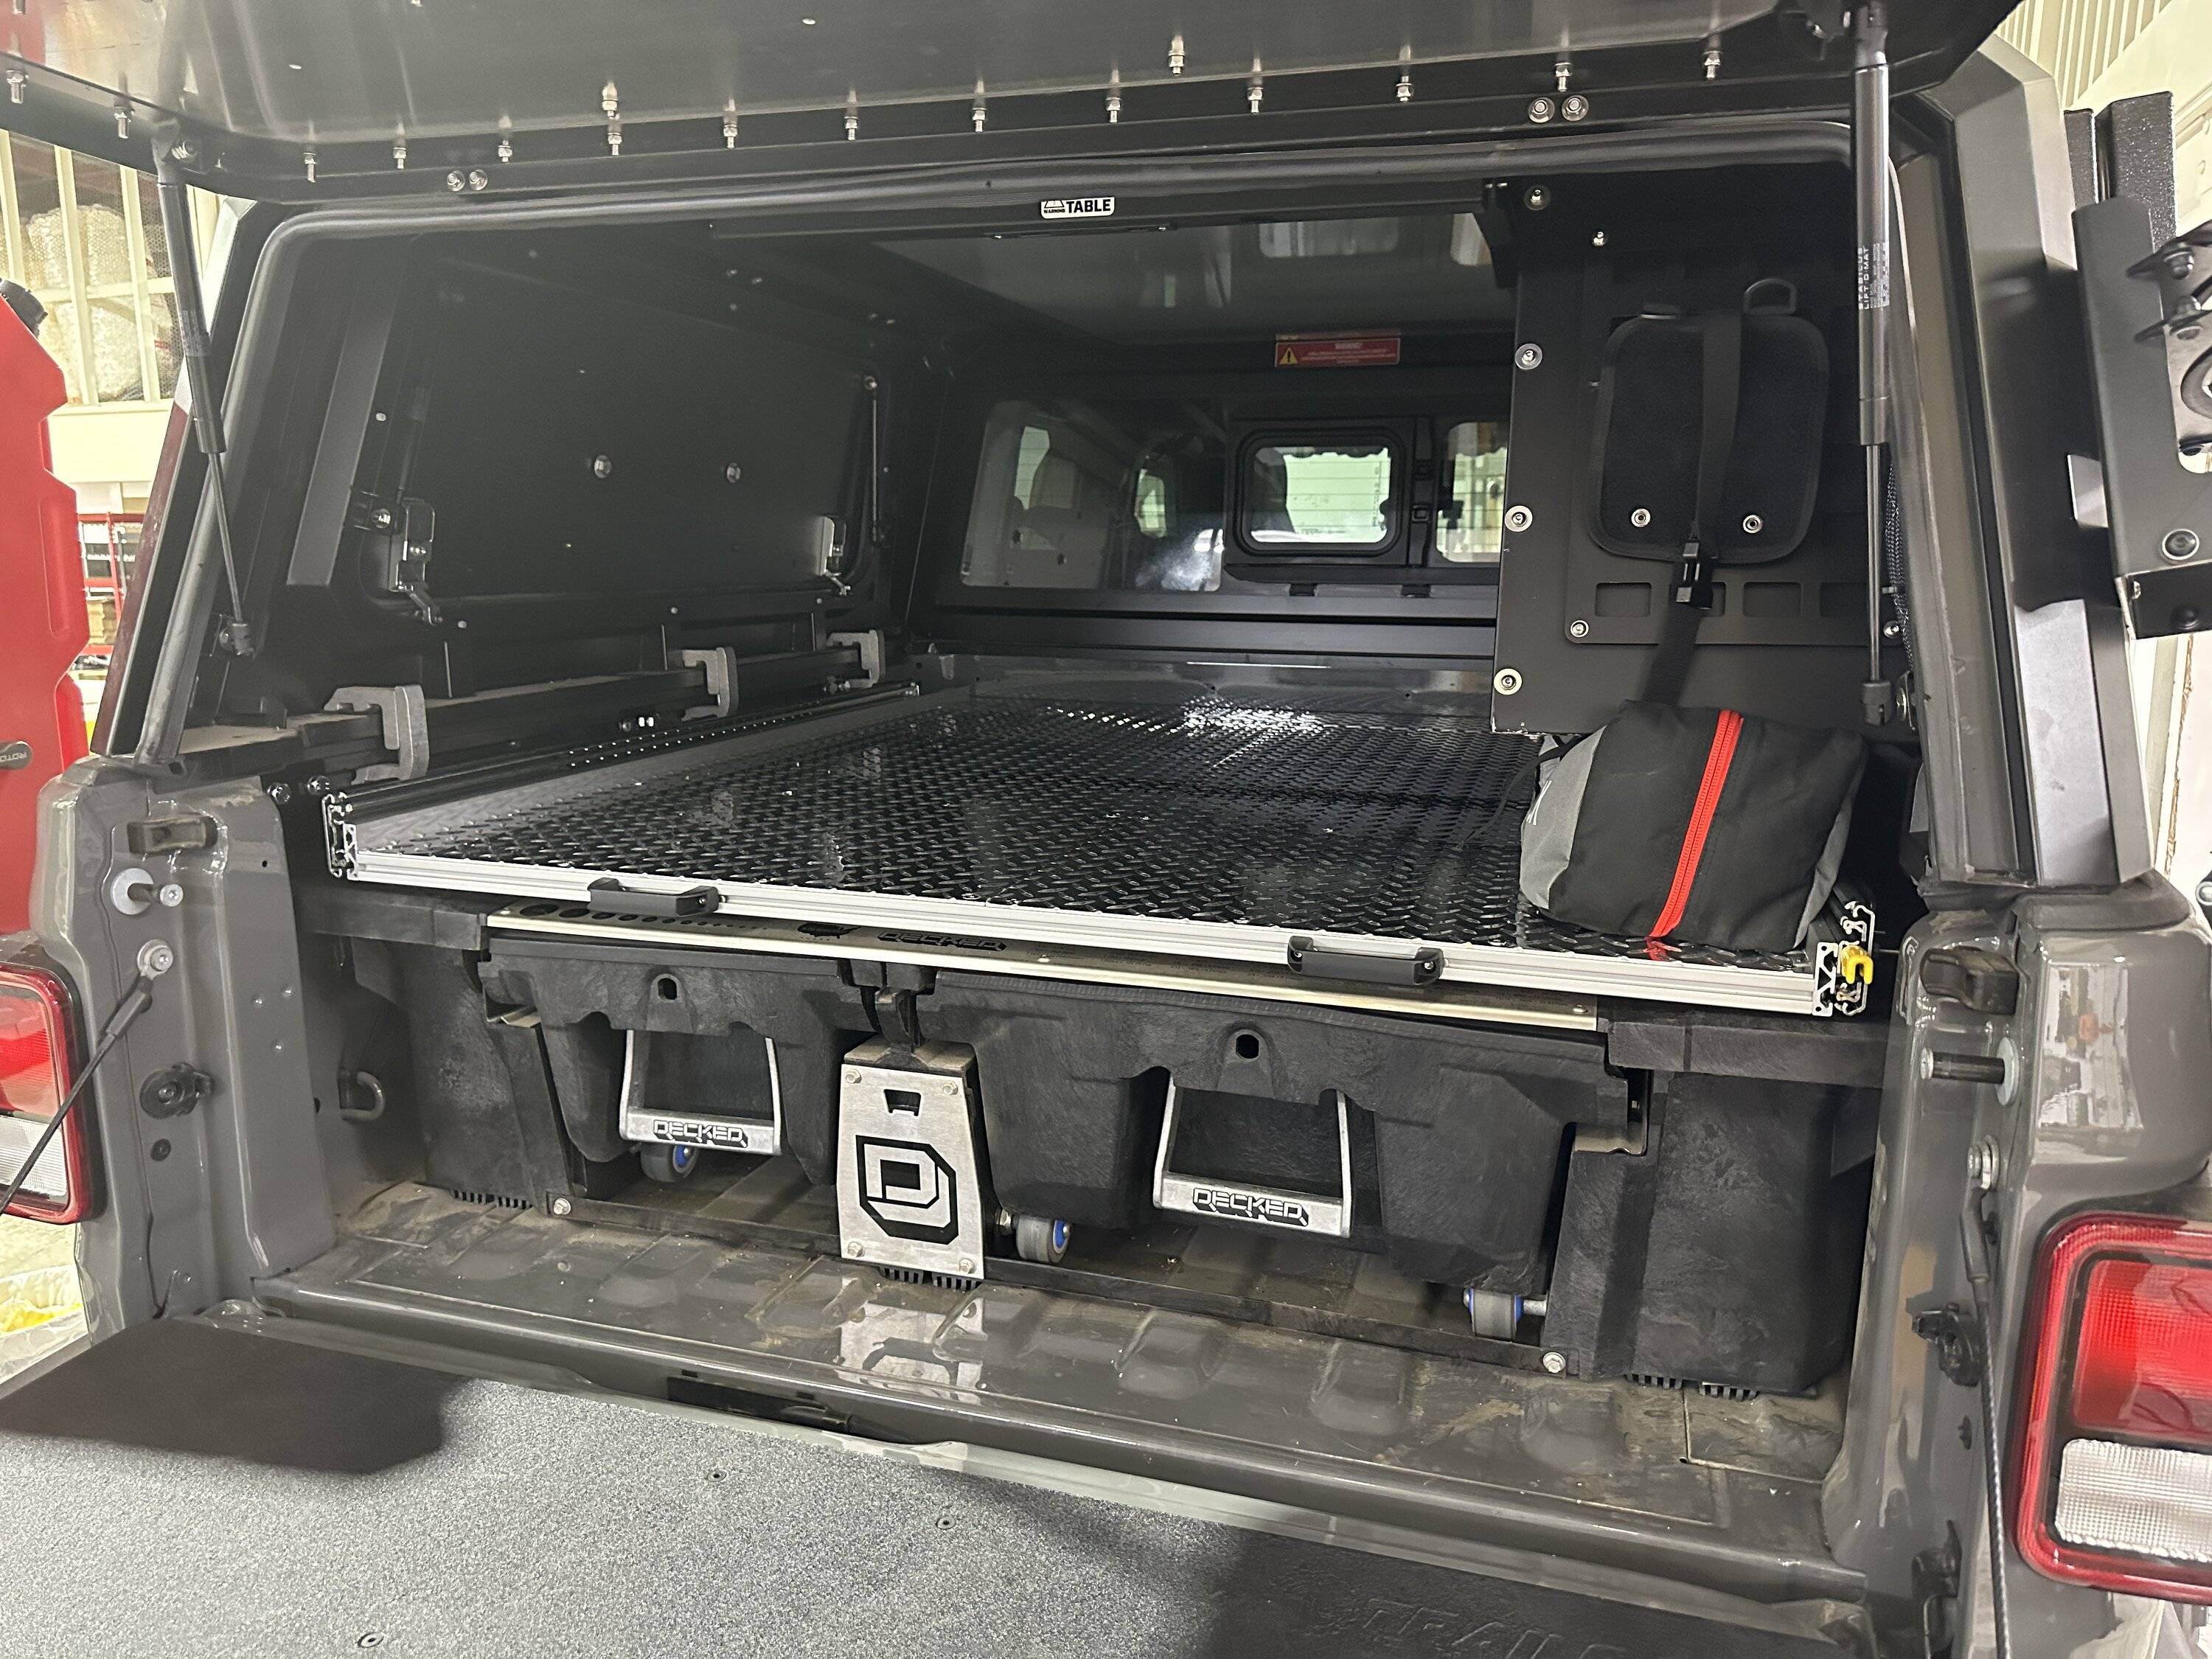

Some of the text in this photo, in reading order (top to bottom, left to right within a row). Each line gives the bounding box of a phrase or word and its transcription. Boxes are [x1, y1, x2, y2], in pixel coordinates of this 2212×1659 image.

[1066, 199, 1111, 213] TABLE
[877, 931, 1007, 952] DECKED
[653, 1119, 748, 1148] DECKED
[1192, 1187, 1310, 1227] DECKED
